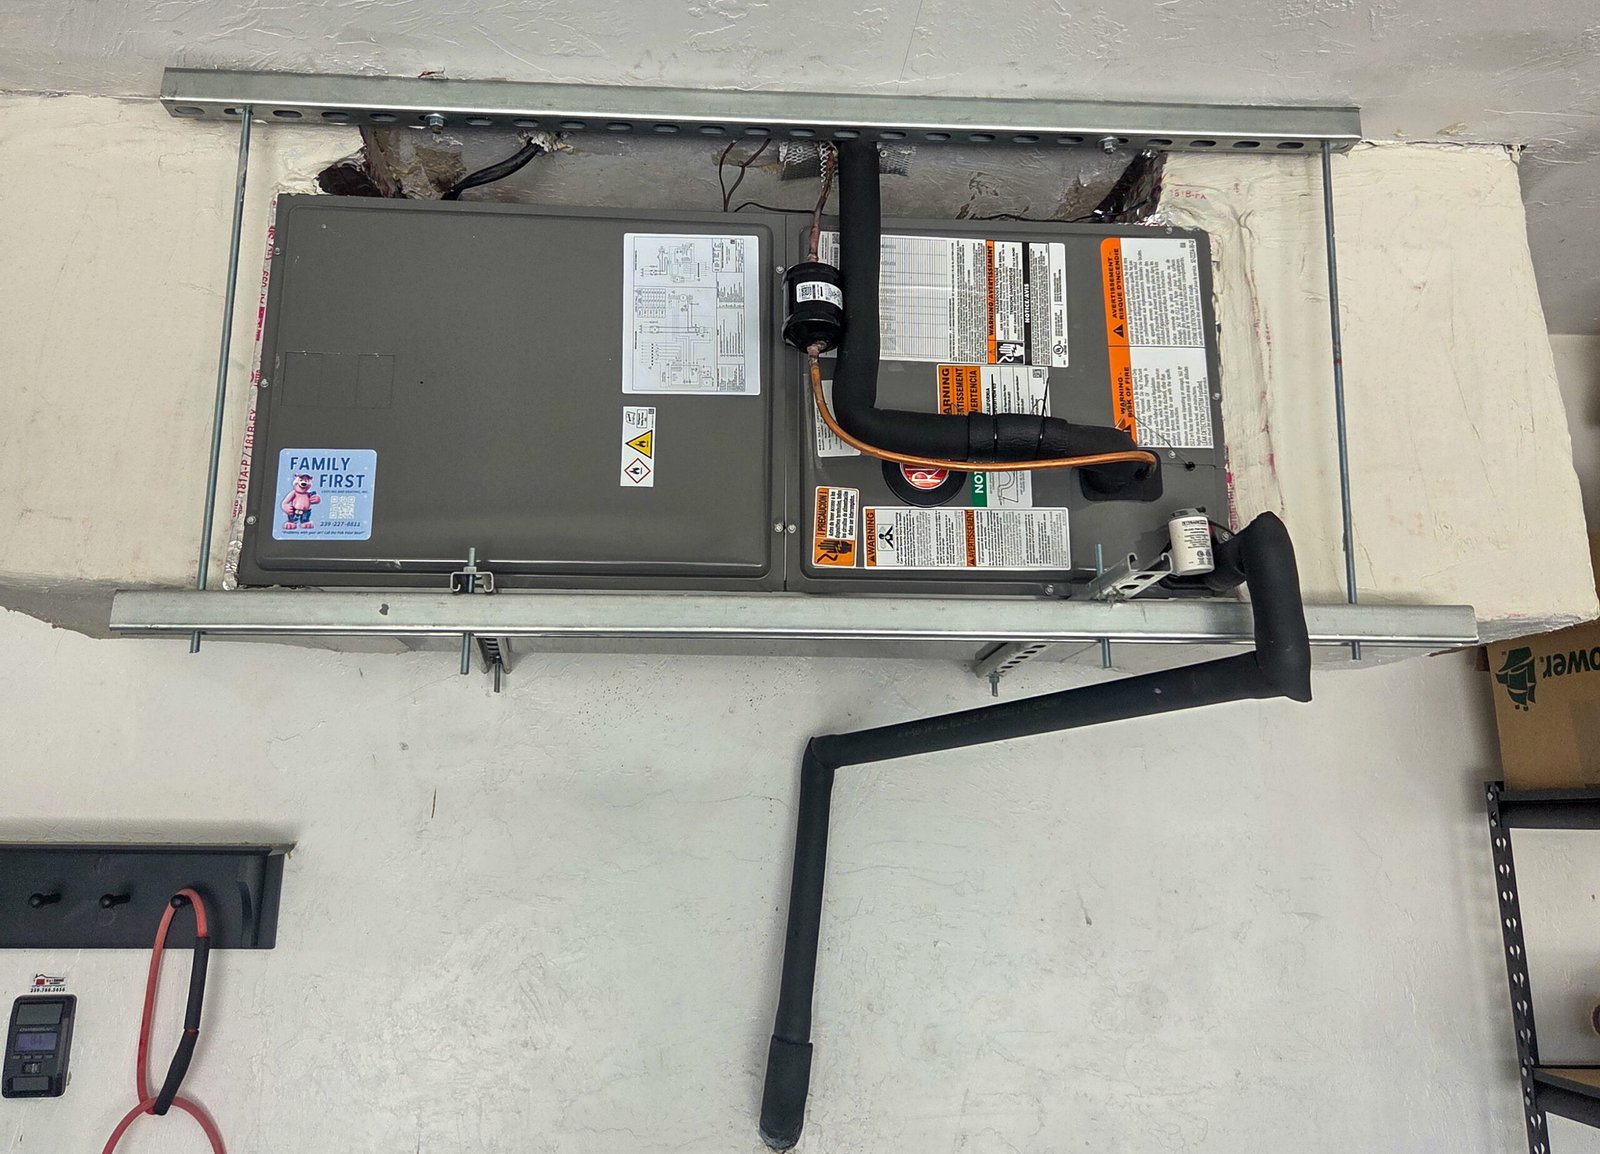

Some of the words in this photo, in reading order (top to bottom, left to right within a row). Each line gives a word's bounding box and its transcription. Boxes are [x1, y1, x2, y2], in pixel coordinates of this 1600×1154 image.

[1107, 257, 1118, 318] AVERTISSEMENT
[1113, 248, 1122, 290] D'INCENDIE
[1117, 292, 1125, 320] RISQUE
[941, 367, 951, 413] ARNING
[969, 369, 978, 411] VERTENCIA
[1115, 376, 1125, 414] WARNING
[1125, 387, 1131, 396] OF
[290, 457, 350, 471] FAMILY
[319, 474, 365, 488] FIRST
[974, 471, 984, 494] NOT
[866, 512, 874, 554] WARNING
[966, 510, 974, 557] AVERTISSEMENT
